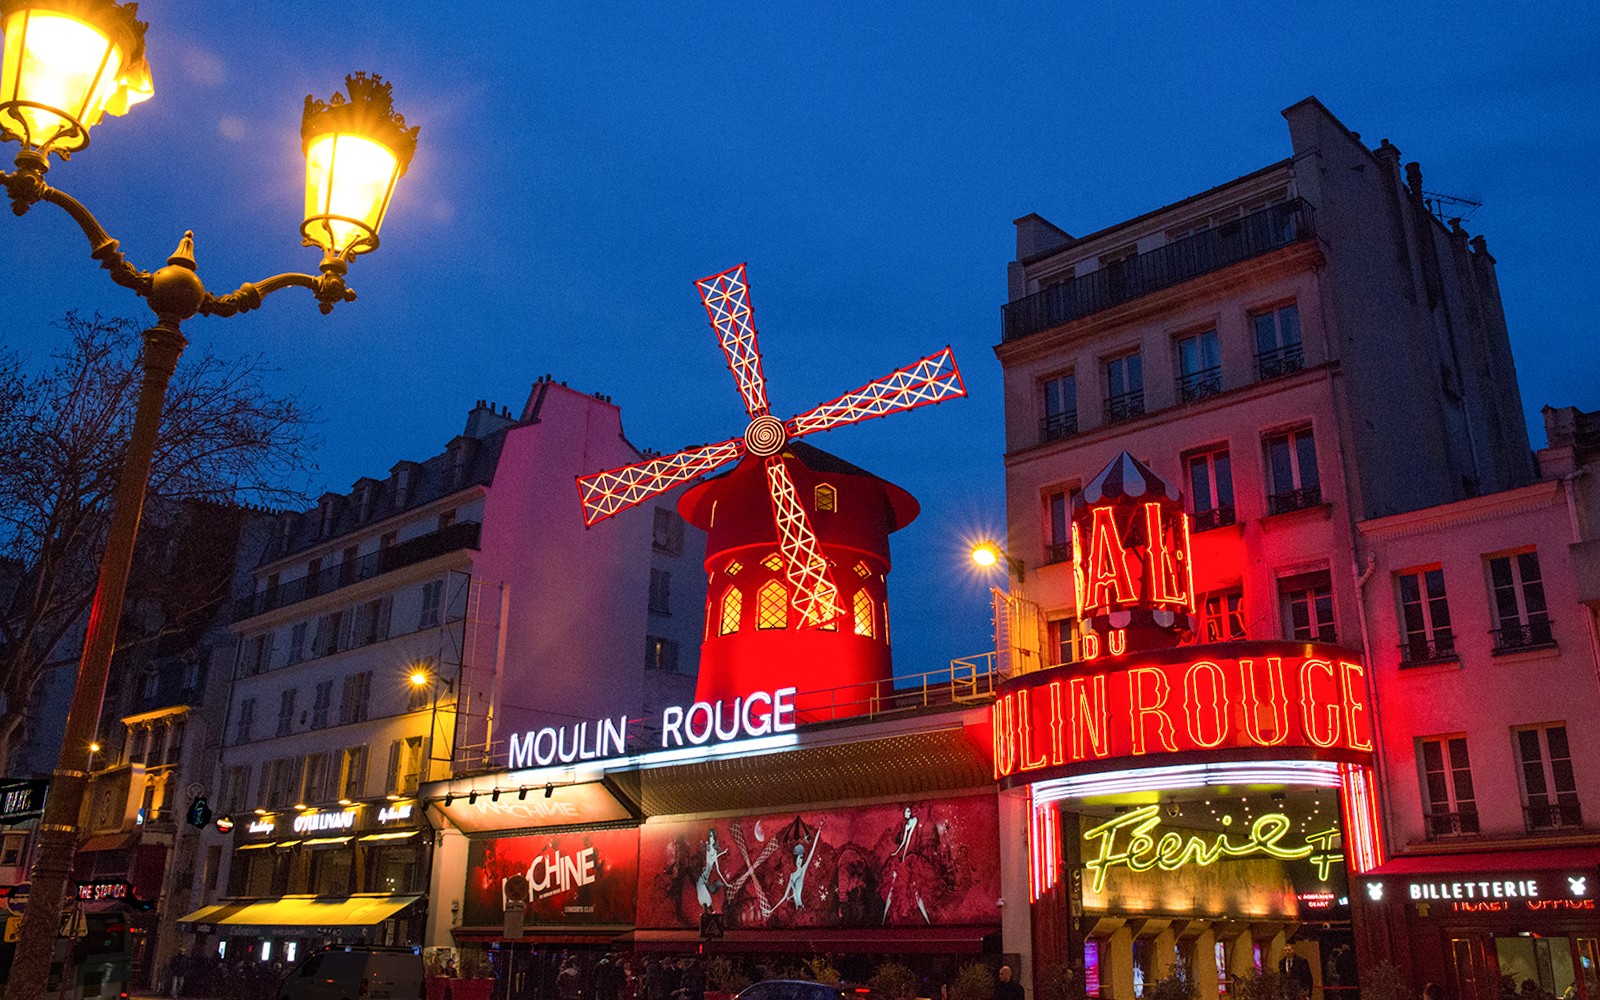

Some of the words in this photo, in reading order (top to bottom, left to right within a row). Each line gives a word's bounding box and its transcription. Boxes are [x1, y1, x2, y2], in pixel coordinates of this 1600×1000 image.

[1072, 502, 1189, 622] AL
[1082, 629, 1126, 661] DU
[508, 714, 627, 769] MOULIN
[661, 687, 796, 747] ROUGE
[993, 674, 1109, 780] ULIN
[1127, 656, 1374, 756] ROUGE
[1084, 805, 1314, 893] Féerie
[1410, 880, 1539, 900] BILLETTERIE
